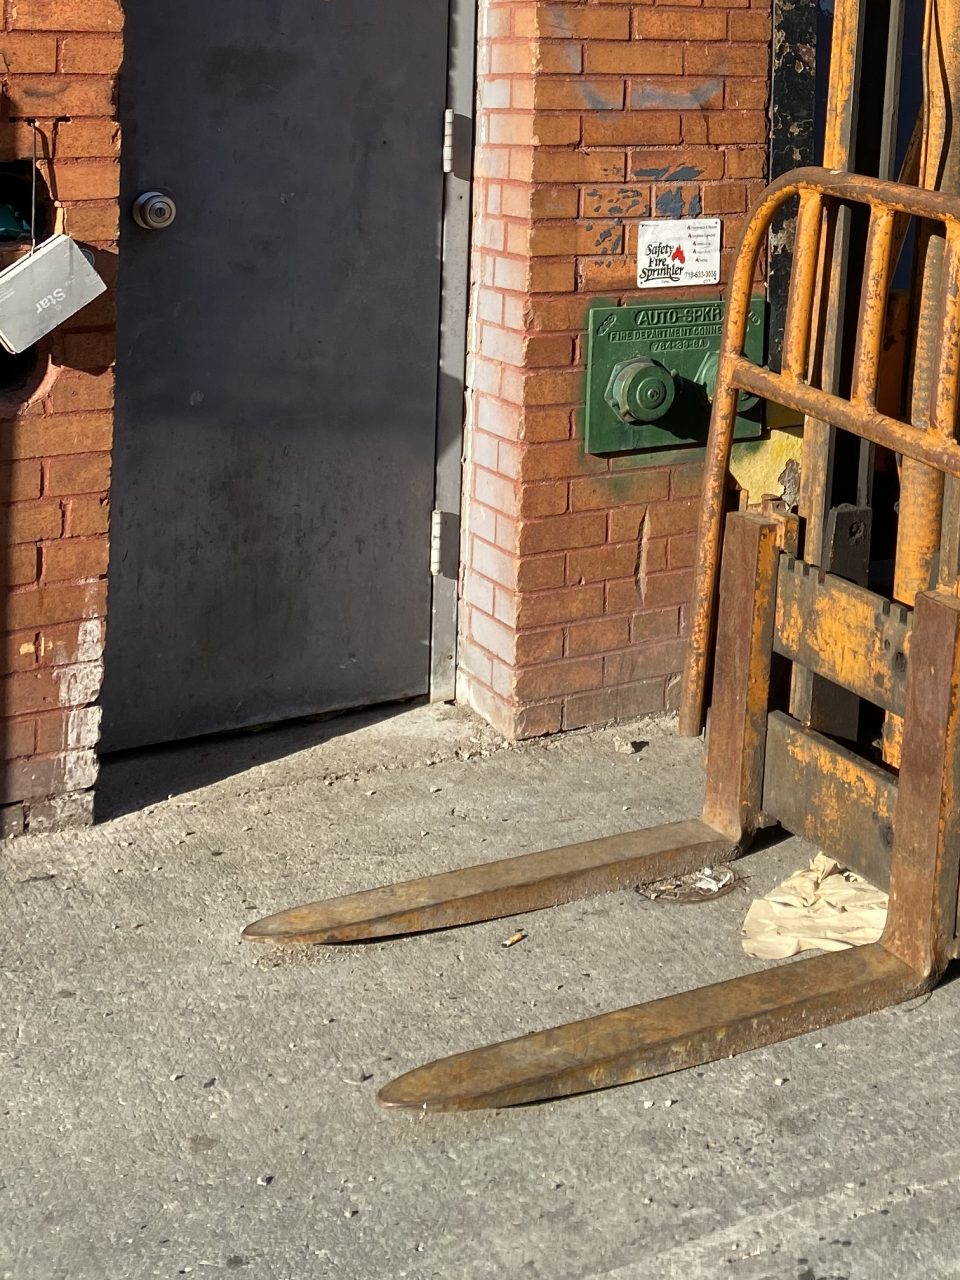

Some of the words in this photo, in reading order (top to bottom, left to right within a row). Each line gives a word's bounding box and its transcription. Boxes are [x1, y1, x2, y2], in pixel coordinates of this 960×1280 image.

[646, 242, 674, 258] Safety
[648, 257, 667, 268] Fire
[639, 263, 684, 282] Sprinkler
[35, 287, 67, 314] Star
[610, 331, 632, 342] FIRE
[633, 326, 691, 340] DEPARTMENT
[692, 324, 722, 336] CONNE
